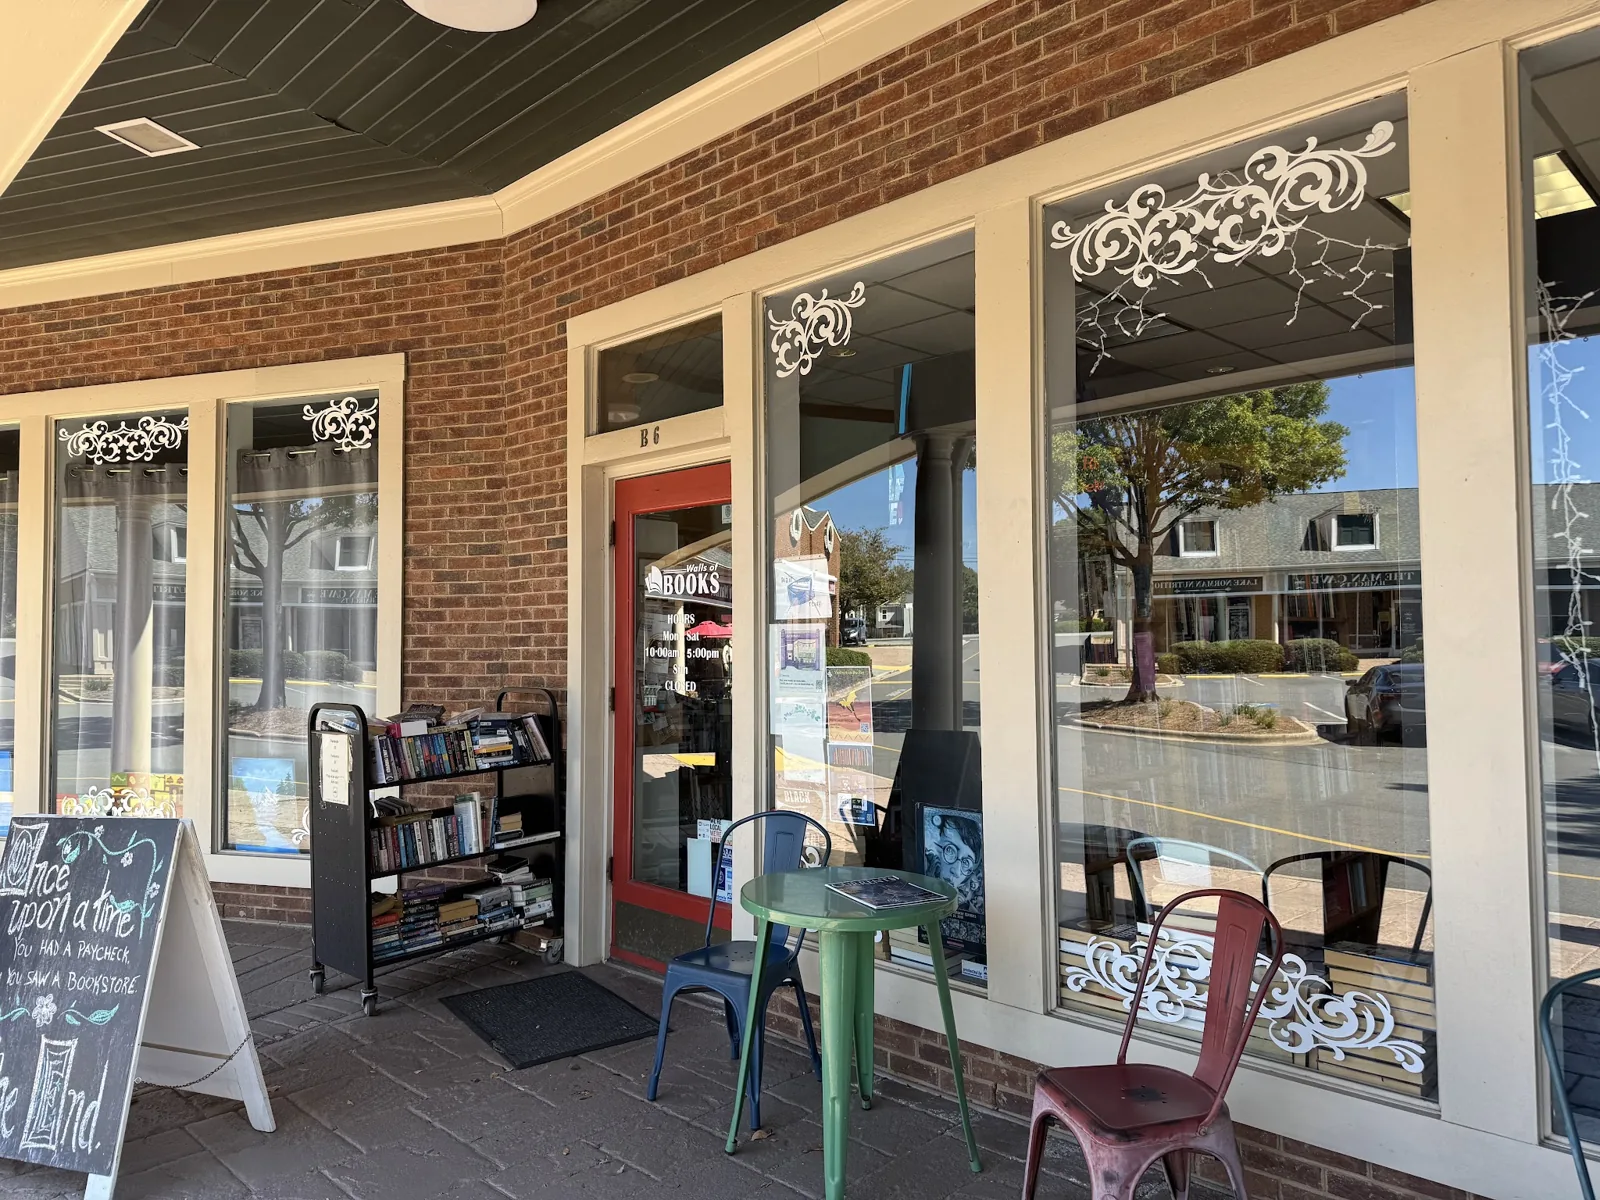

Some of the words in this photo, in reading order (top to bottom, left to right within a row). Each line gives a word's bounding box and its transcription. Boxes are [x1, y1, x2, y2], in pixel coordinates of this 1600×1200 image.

[640, 428, 648, 448] B
[653, 425, 660, 445] 6
[686, 563, 707, 572] Walls
[709, 563, 718, 572] of
[664, 572, 720, 595] BOOKS
[687, 648, 720, 660] 5:00pm
[7, 892, 71, 941] upon
[73, 899, 90, 931] a
[39, 939, 60, 957] HAD
[63, 941, 72, 957] A
[24, 970, 51, 987] SAW
[51, 970, 61, 989] A
